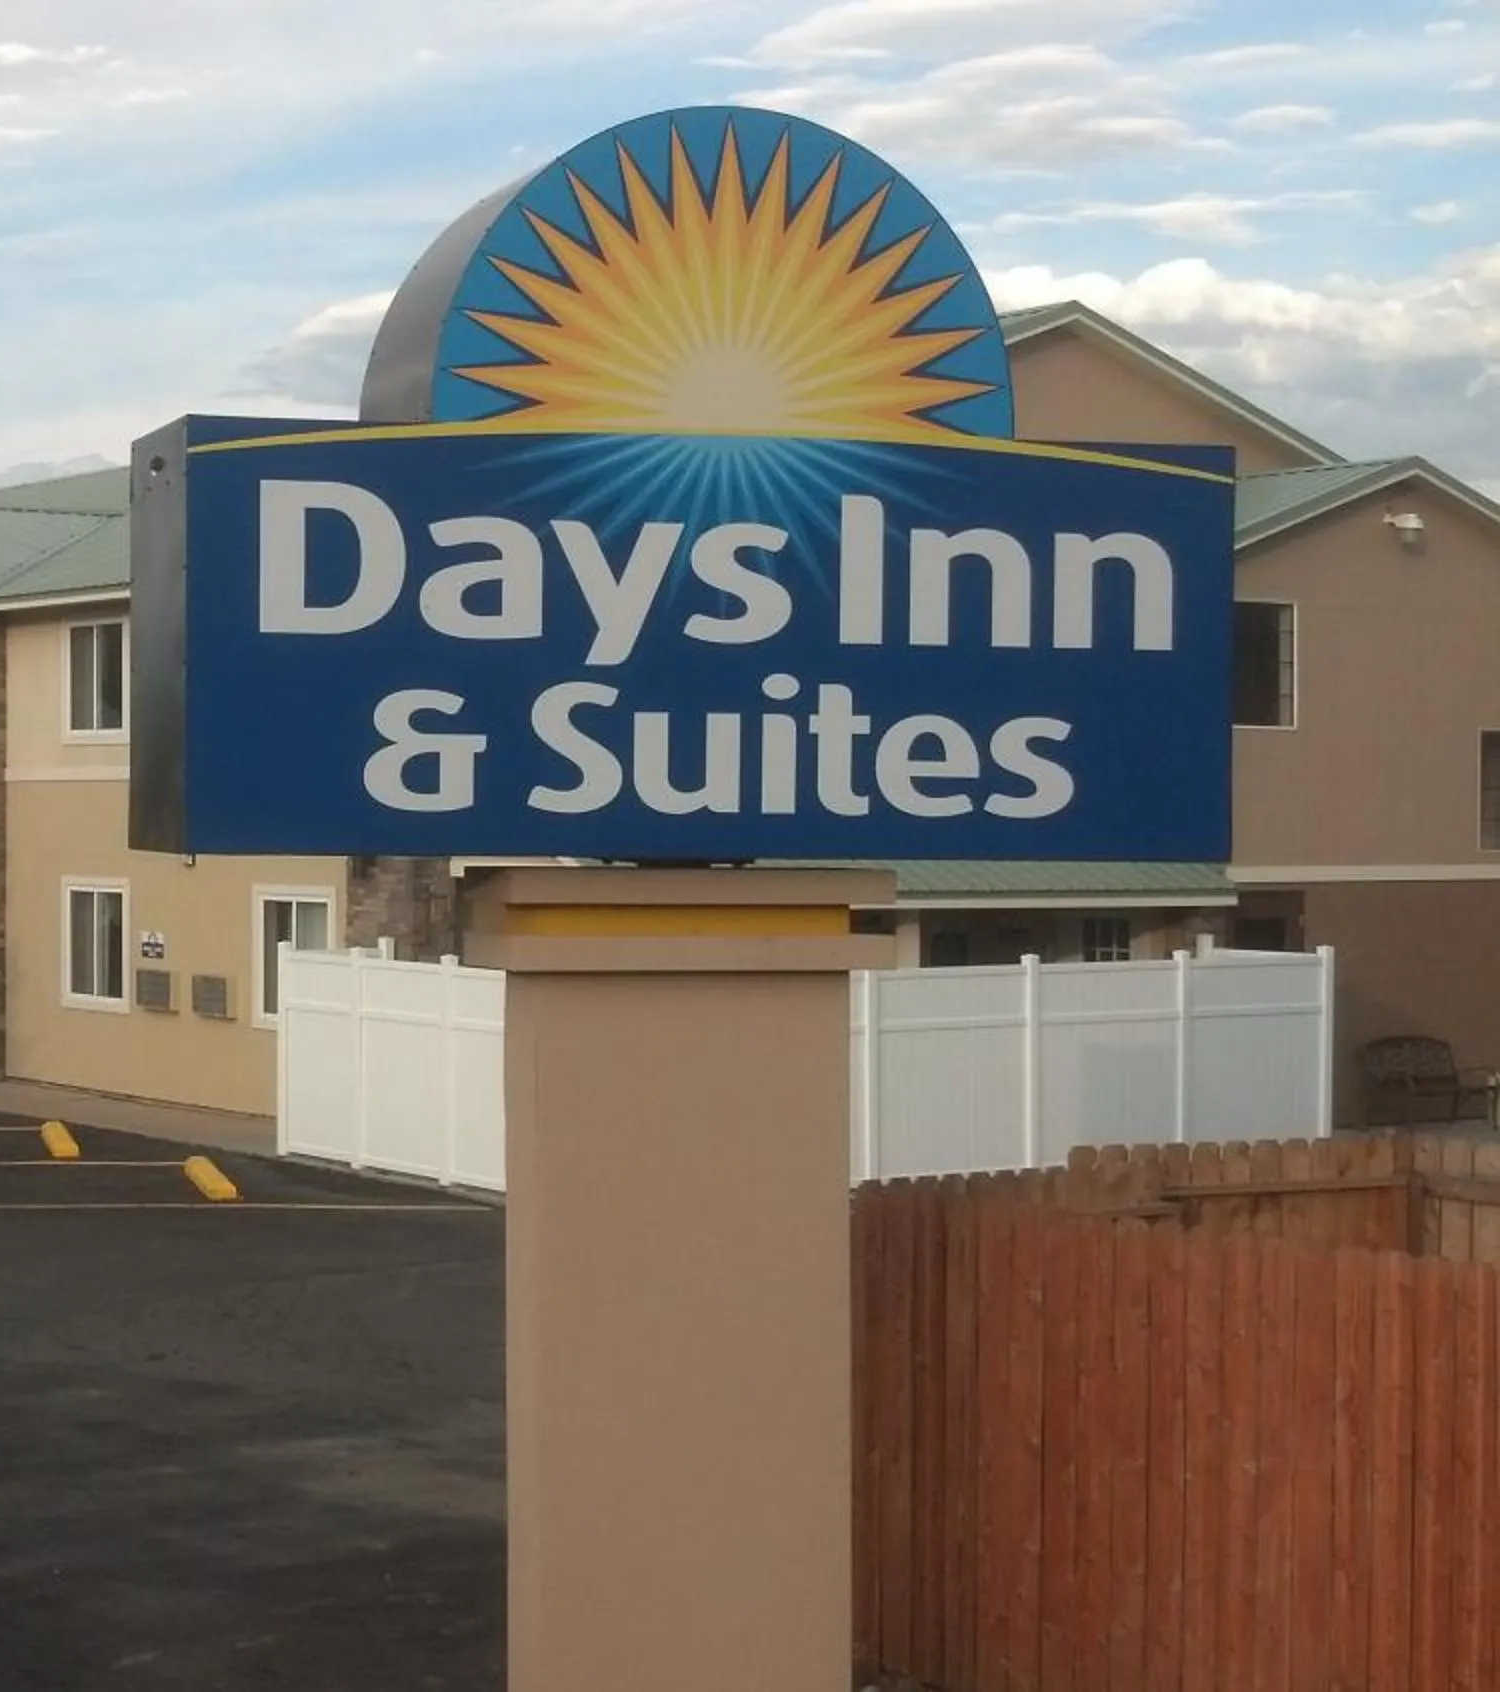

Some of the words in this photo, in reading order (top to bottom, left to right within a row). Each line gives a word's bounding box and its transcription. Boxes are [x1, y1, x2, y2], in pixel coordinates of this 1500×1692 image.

[258, 479, 793, 666] Days
[838, 494, 1174, 651] Inn
[363, 688, 488, 812] &
[527, 673, 1076, 818] Suites
